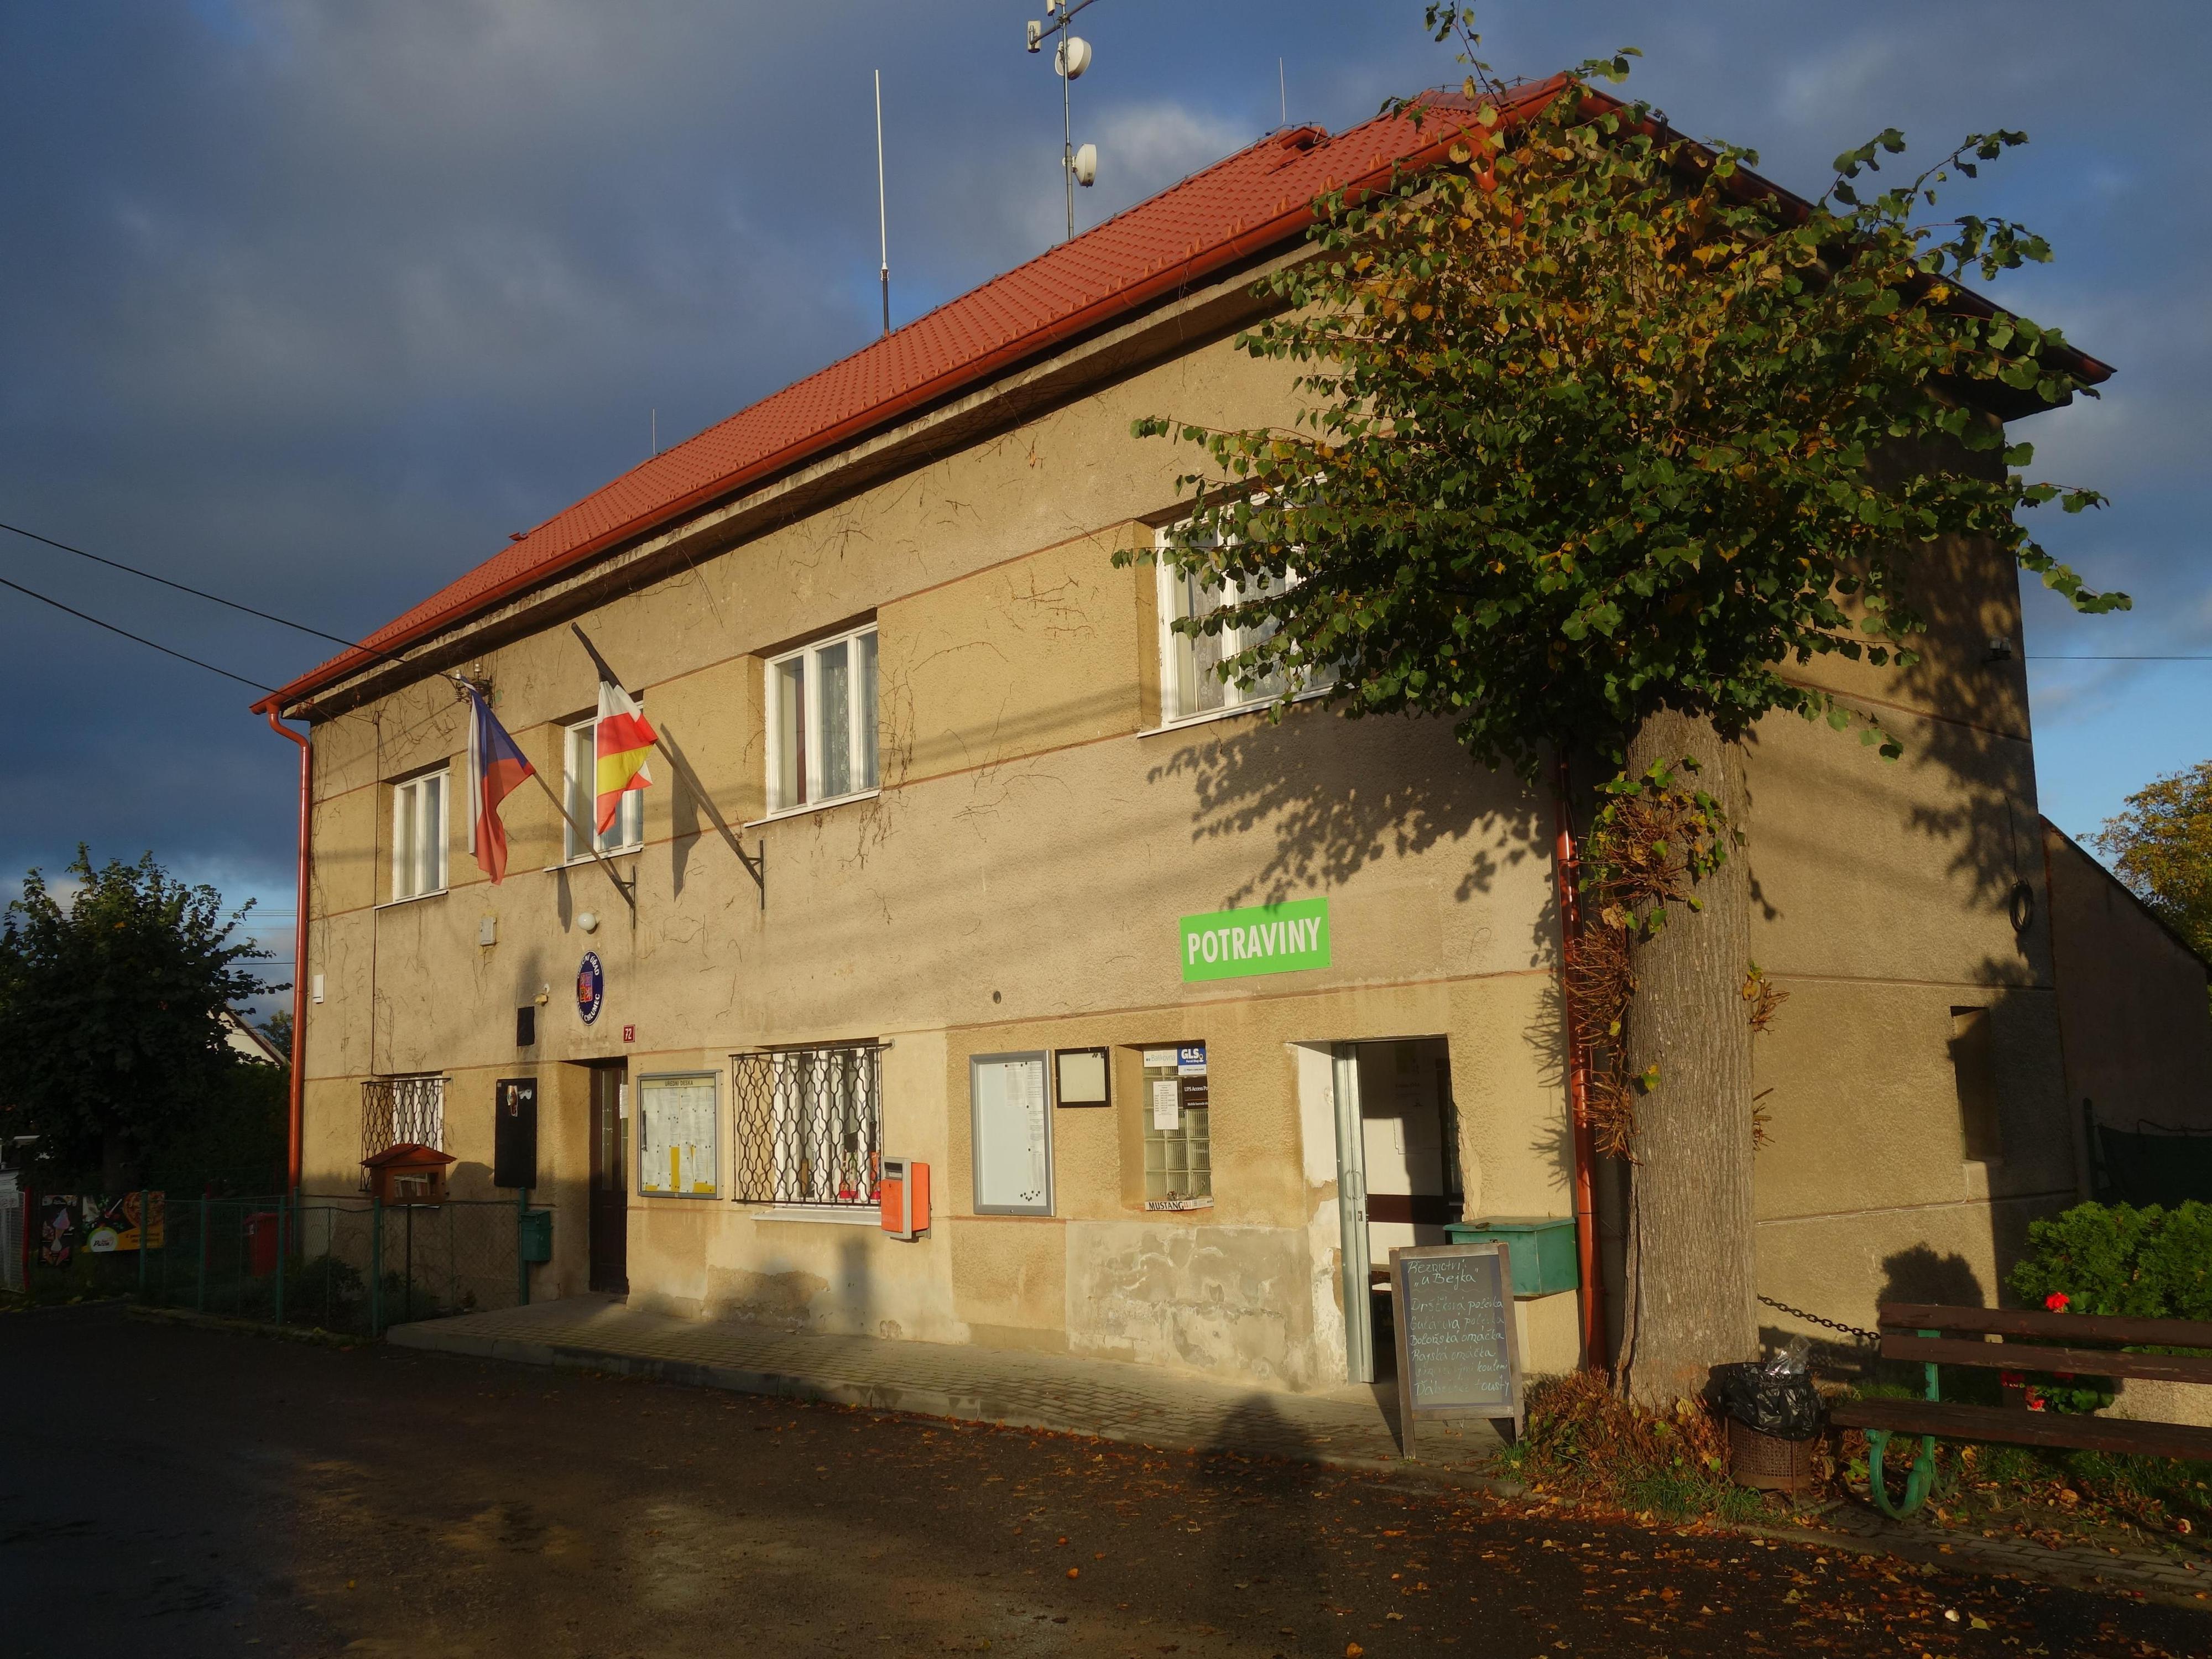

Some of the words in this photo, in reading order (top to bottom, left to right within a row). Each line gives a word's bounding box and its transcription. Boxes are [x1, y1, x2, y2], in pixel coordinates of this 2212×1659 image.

[1187, 916, 1322, 965] POTRAVINY
[589, 955, 600, 976] ÚŘAD
[584, 993, 601, 1022] CHLUMEC
[624, 1028, 632, 1040] 72
[1181, 1048, 1199, 1060] GLS
[1149, 1201, 1185, 1211] MUSTANG
[1410, 1312, 1460, 1331] Guláová
[1461, 1325, 1505, 1344] omáčka
[1411, 1346, 1448, 1363] Rajská
[1451, 1345, 1496, 1360] omáčka
